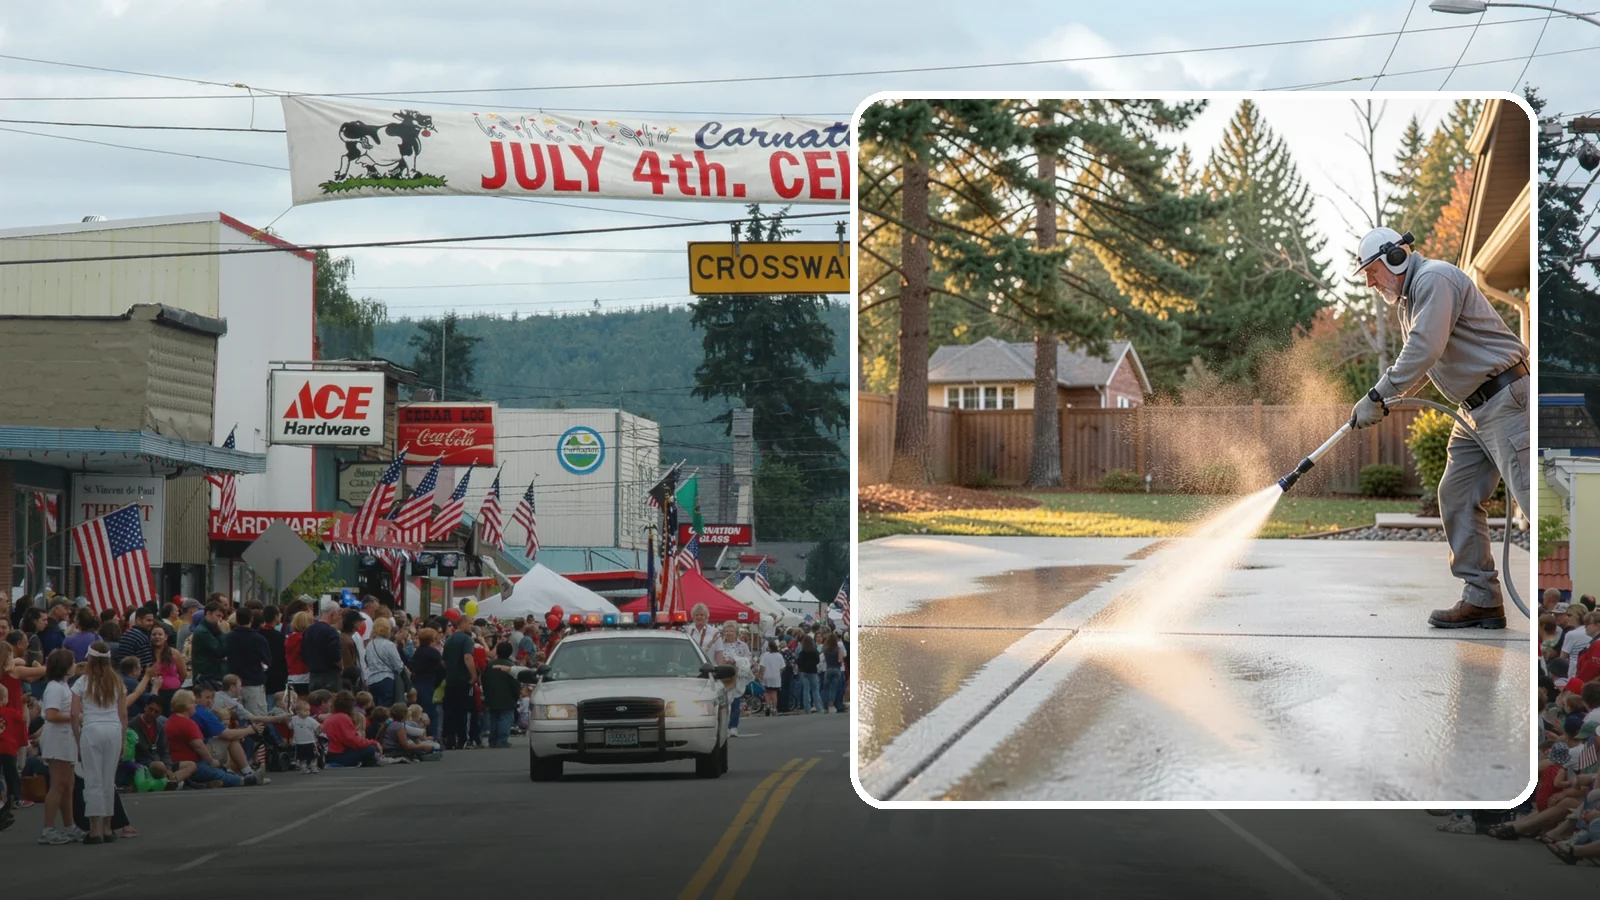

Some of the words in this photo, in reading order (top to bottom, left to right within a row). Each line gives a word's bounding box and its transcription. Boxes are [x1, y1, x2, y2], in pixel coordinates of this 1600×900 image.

[481, 141, 604, 192] JULY
[632, 149, 746, 198] 4th.
[697, 254, 850, 280] CROSSWA
[283, 380, 373, 420] ACE
[405, 409, 452, 422] CEDAR
[283, 421, 371, 436] Hardware
[416, 428, 477, 447] Coca-Cola
[95, 485, 124, 495] Vincent
[126, 486, 135, 495] de
[137, 486, 155, 495] Paul
[81, 503, 154, 522] THT
[212, 516, 331, 536] HARDARE
[688, 526, 741, 535] CRNATION
[699, 535, 730, 543] GLASS
